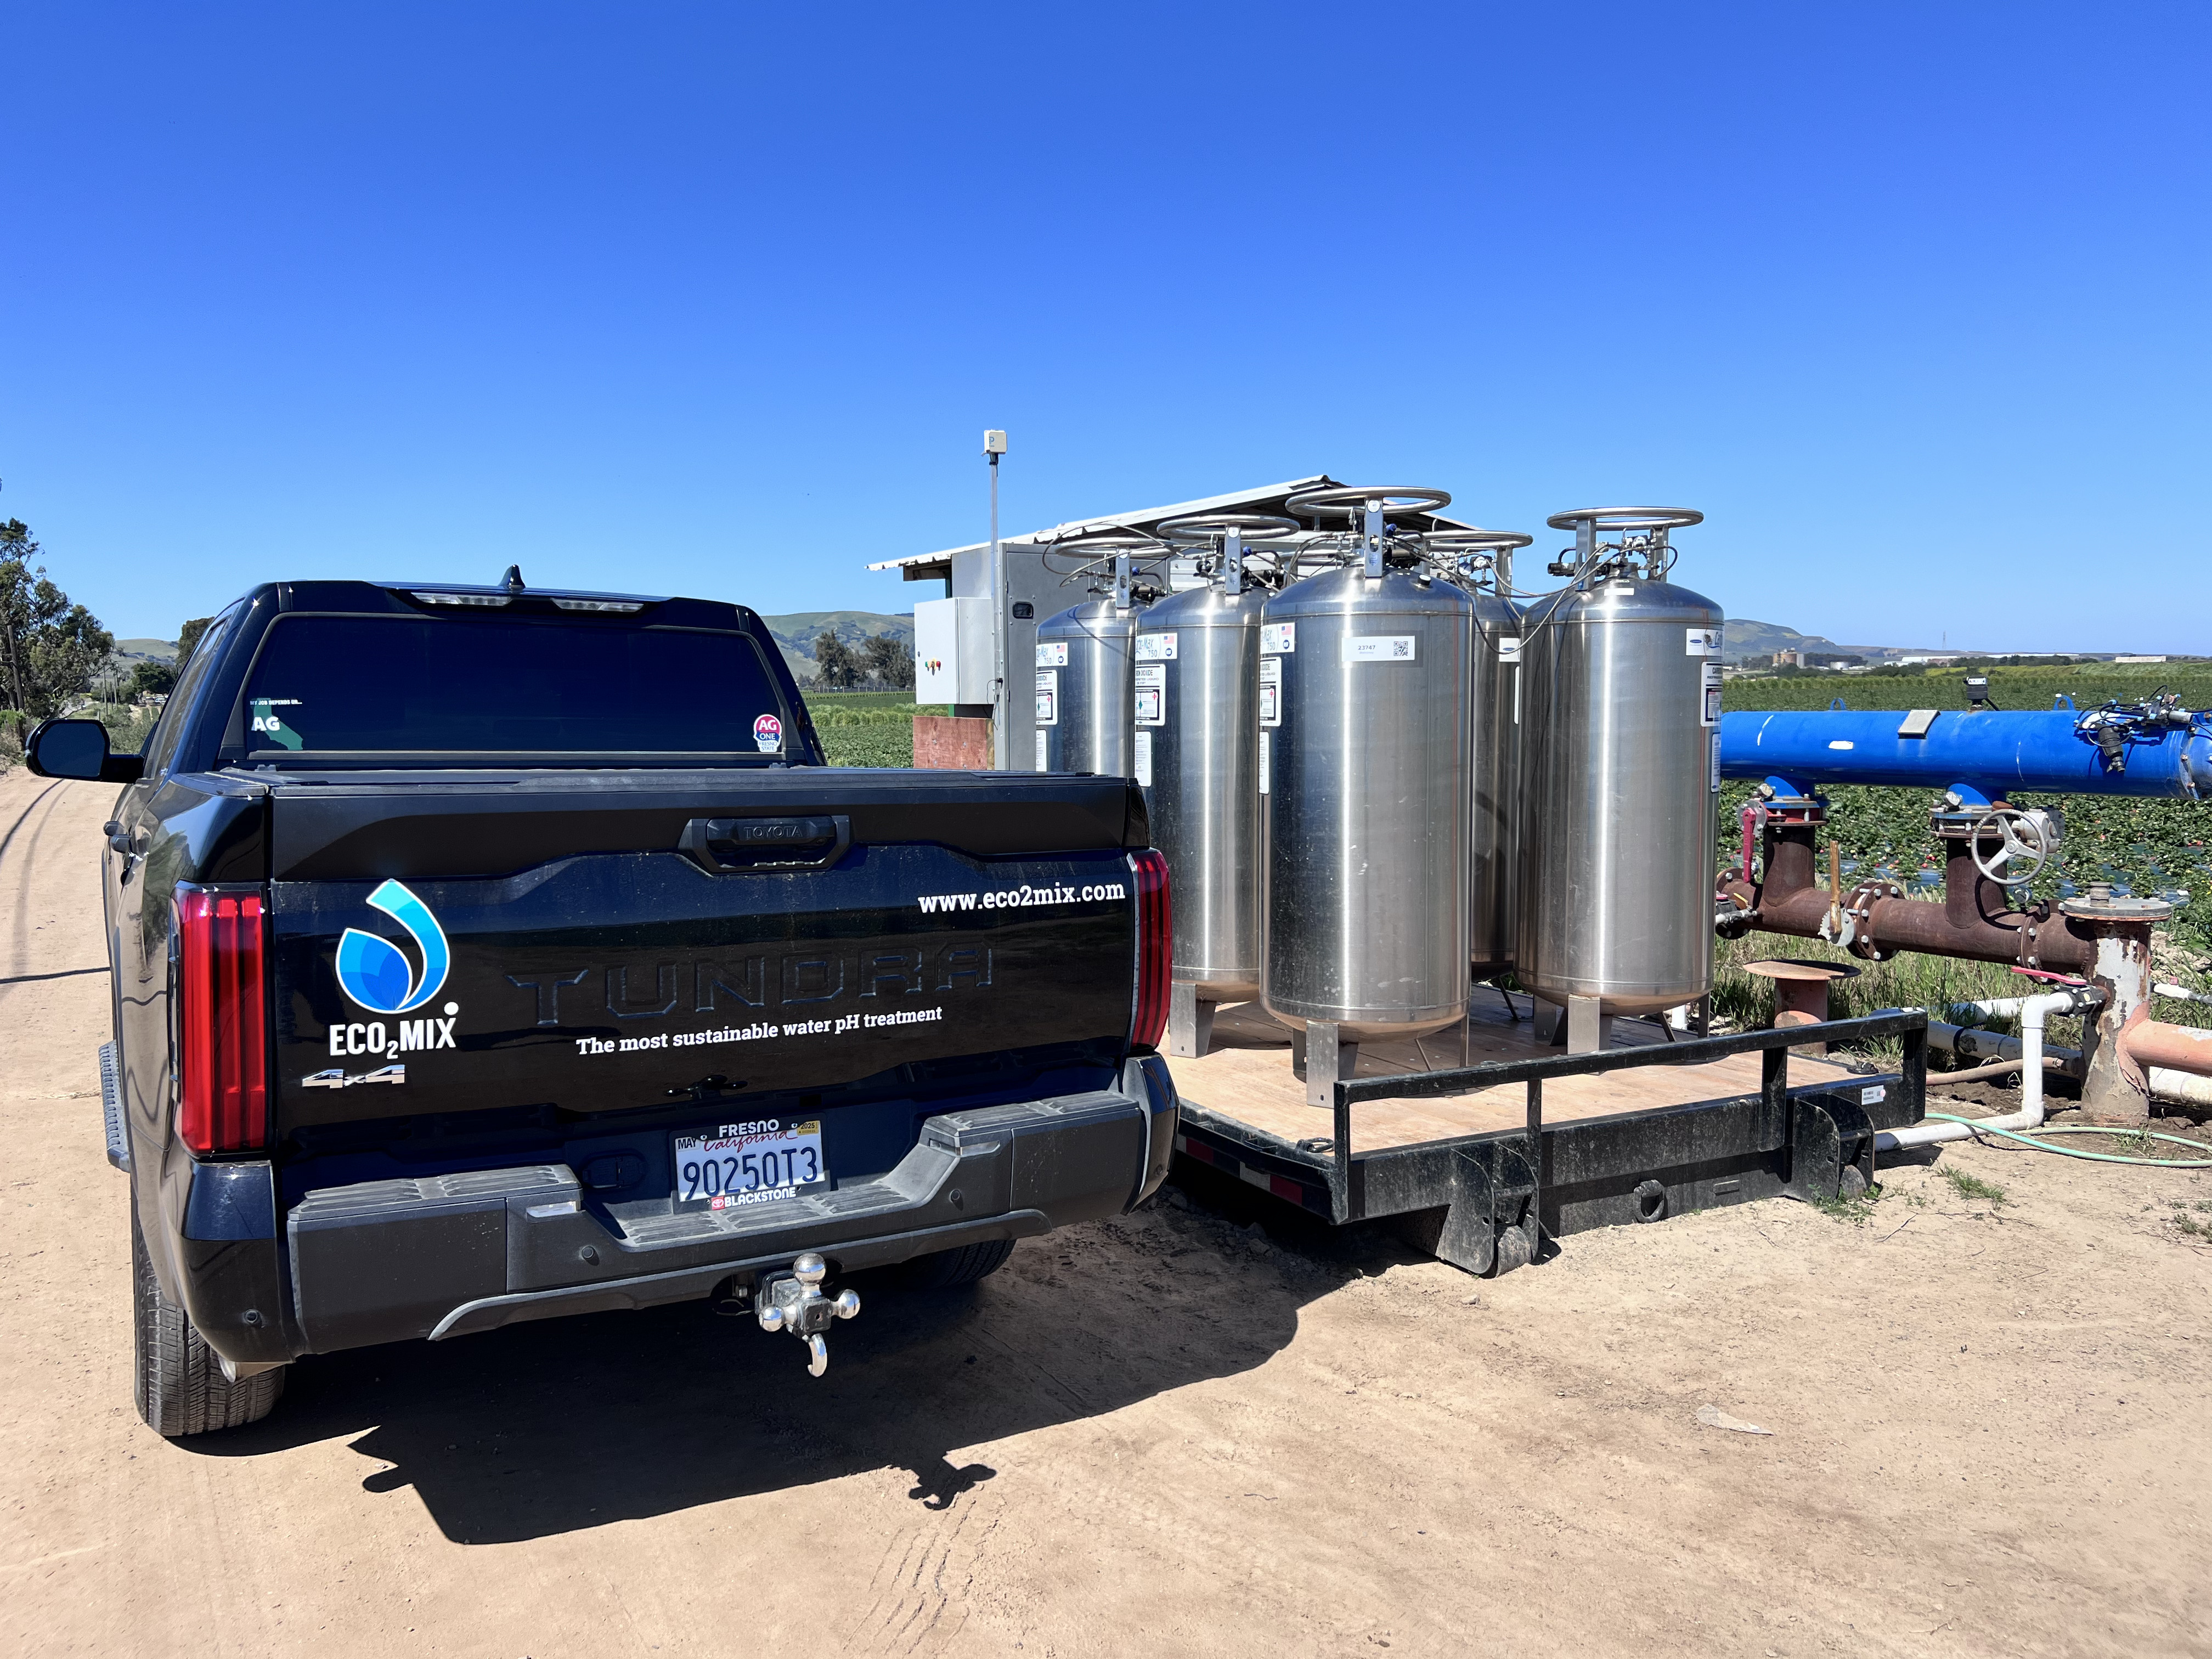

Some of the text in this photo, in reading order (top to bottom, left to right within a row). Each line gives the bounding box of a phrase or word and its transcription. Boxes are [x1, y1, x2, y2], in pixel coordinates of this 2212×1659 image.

[1148, 649, 1158, 658] 750
[1267, 642, 1276, 651] 750
[251, 716, 280, 731] AG
[758, 719, 777, 731] AG
[743, 826, 803, 839] TOYOTA
[917, 882, 1126, 913] www.eco2mix.com
[504, 941, 992, 1026] TUNDRA
[575, 1006, 943, 1055] The most sustainable water pH treatment
[302, 1064, 405, 1089] 4x4
[719, 1119, 780, 1138] FRESNO
[678, 1137, 697, 1150] MAY
[703, 1130, 799, 1153] California
[683, 1146, 817, 1200] 90250T3
[724, 1187, 797, 1207] BLACKSTONE
